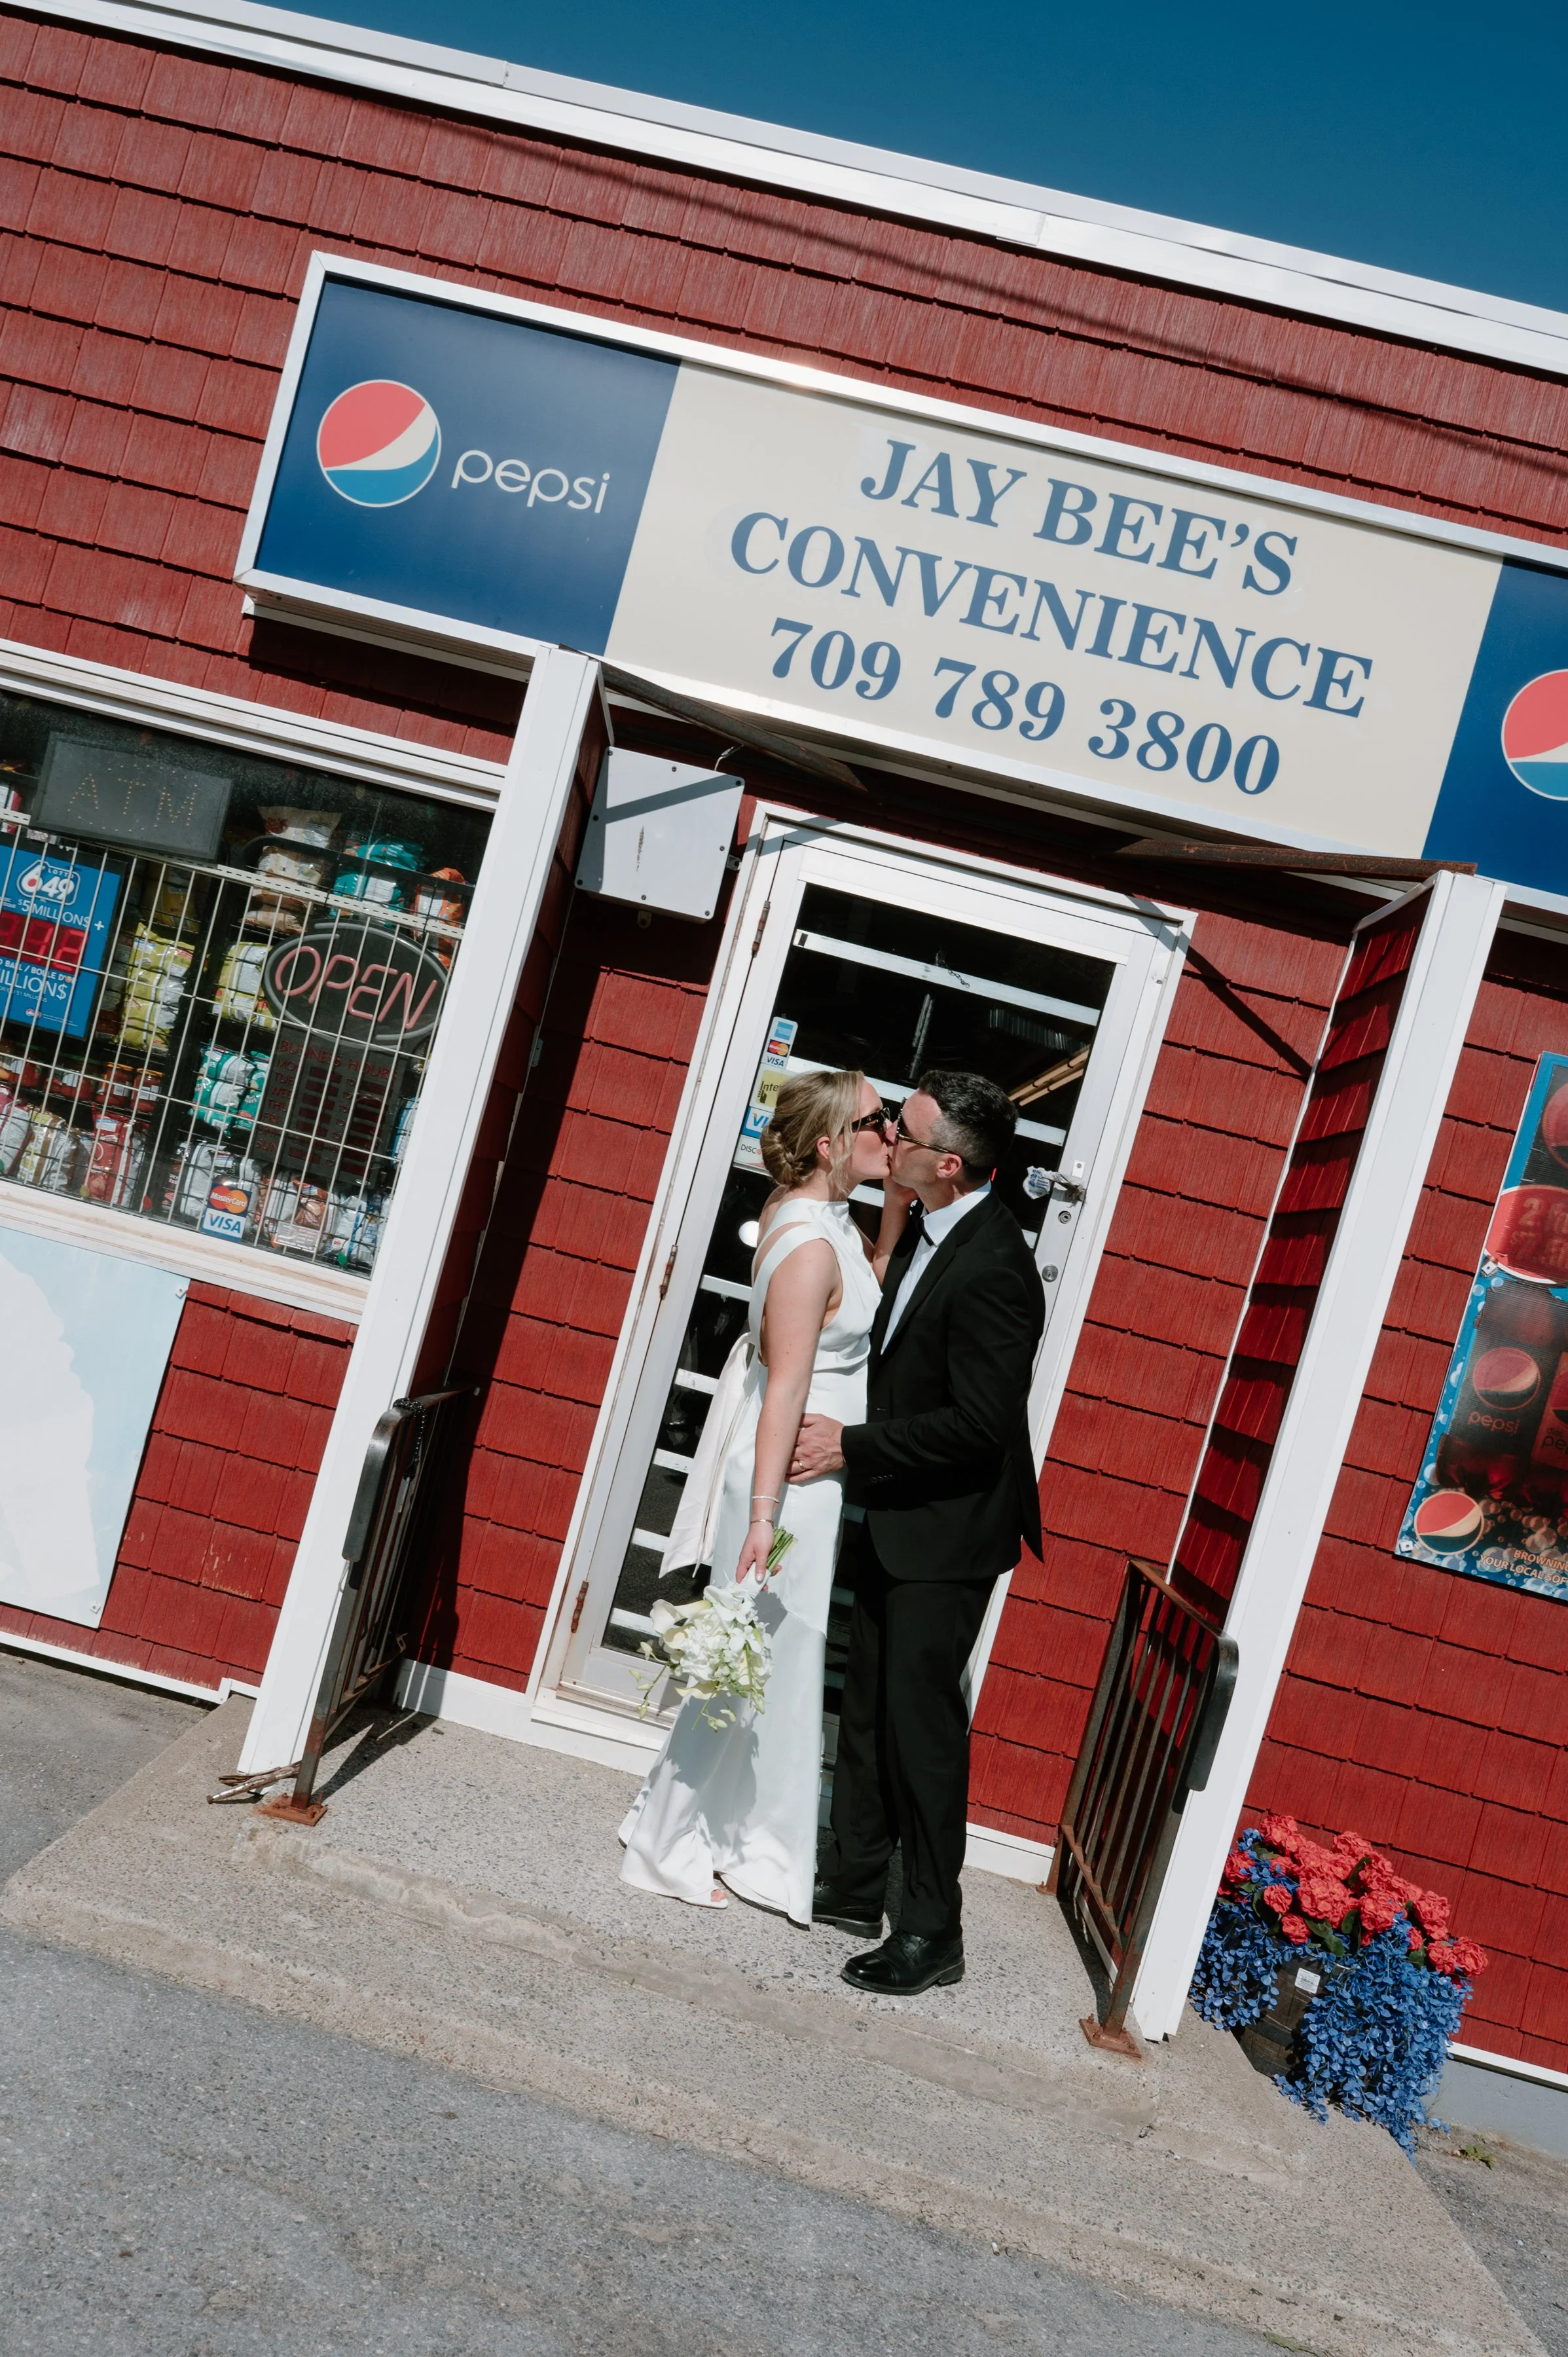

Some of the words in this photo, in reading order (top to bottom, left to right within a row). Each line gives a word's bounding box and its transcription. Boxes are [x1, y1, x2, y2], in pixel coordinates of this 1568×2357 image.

[451, 450, 610, 513] pepsi
[860, 439, 1027, 527] JAY
[1033, 479, 1298, 596] BEE'S
[731, 511, 1374, 718] CONVENIENCE
[771, 617, 901, 701] 709
[933, 657, 1065, 741] 789
[1089, 698, 1281, 795] 3800
[67, 773, 196, 826] ATM
[48, 868, 75, 879] LOTTO
[32, 903, 91, 928] MILLON
[5, 960, 23, 971] BAL
[0, 969, 68, 1000] ILLION$
[275, 945, 437, 1030] OPEN
[767, 1055, 784, 1067] VISA
[759, 1081, 781, 1093] Inte
[752, 1112, 769, 1129] VI
[740, 1144, 763, 1156] DISCO
[210, 1192, 247, 1208] MasterCard
[209, 1213, 241, 1233] VISA
[1467, 1412, 1520, 1434] pepsi
[1480, 1554, 1509, 1570] YOUR
[1510, 1563, 1543, 1579] LOCAL
[1546, 1573, 1568, 1584] SOF
